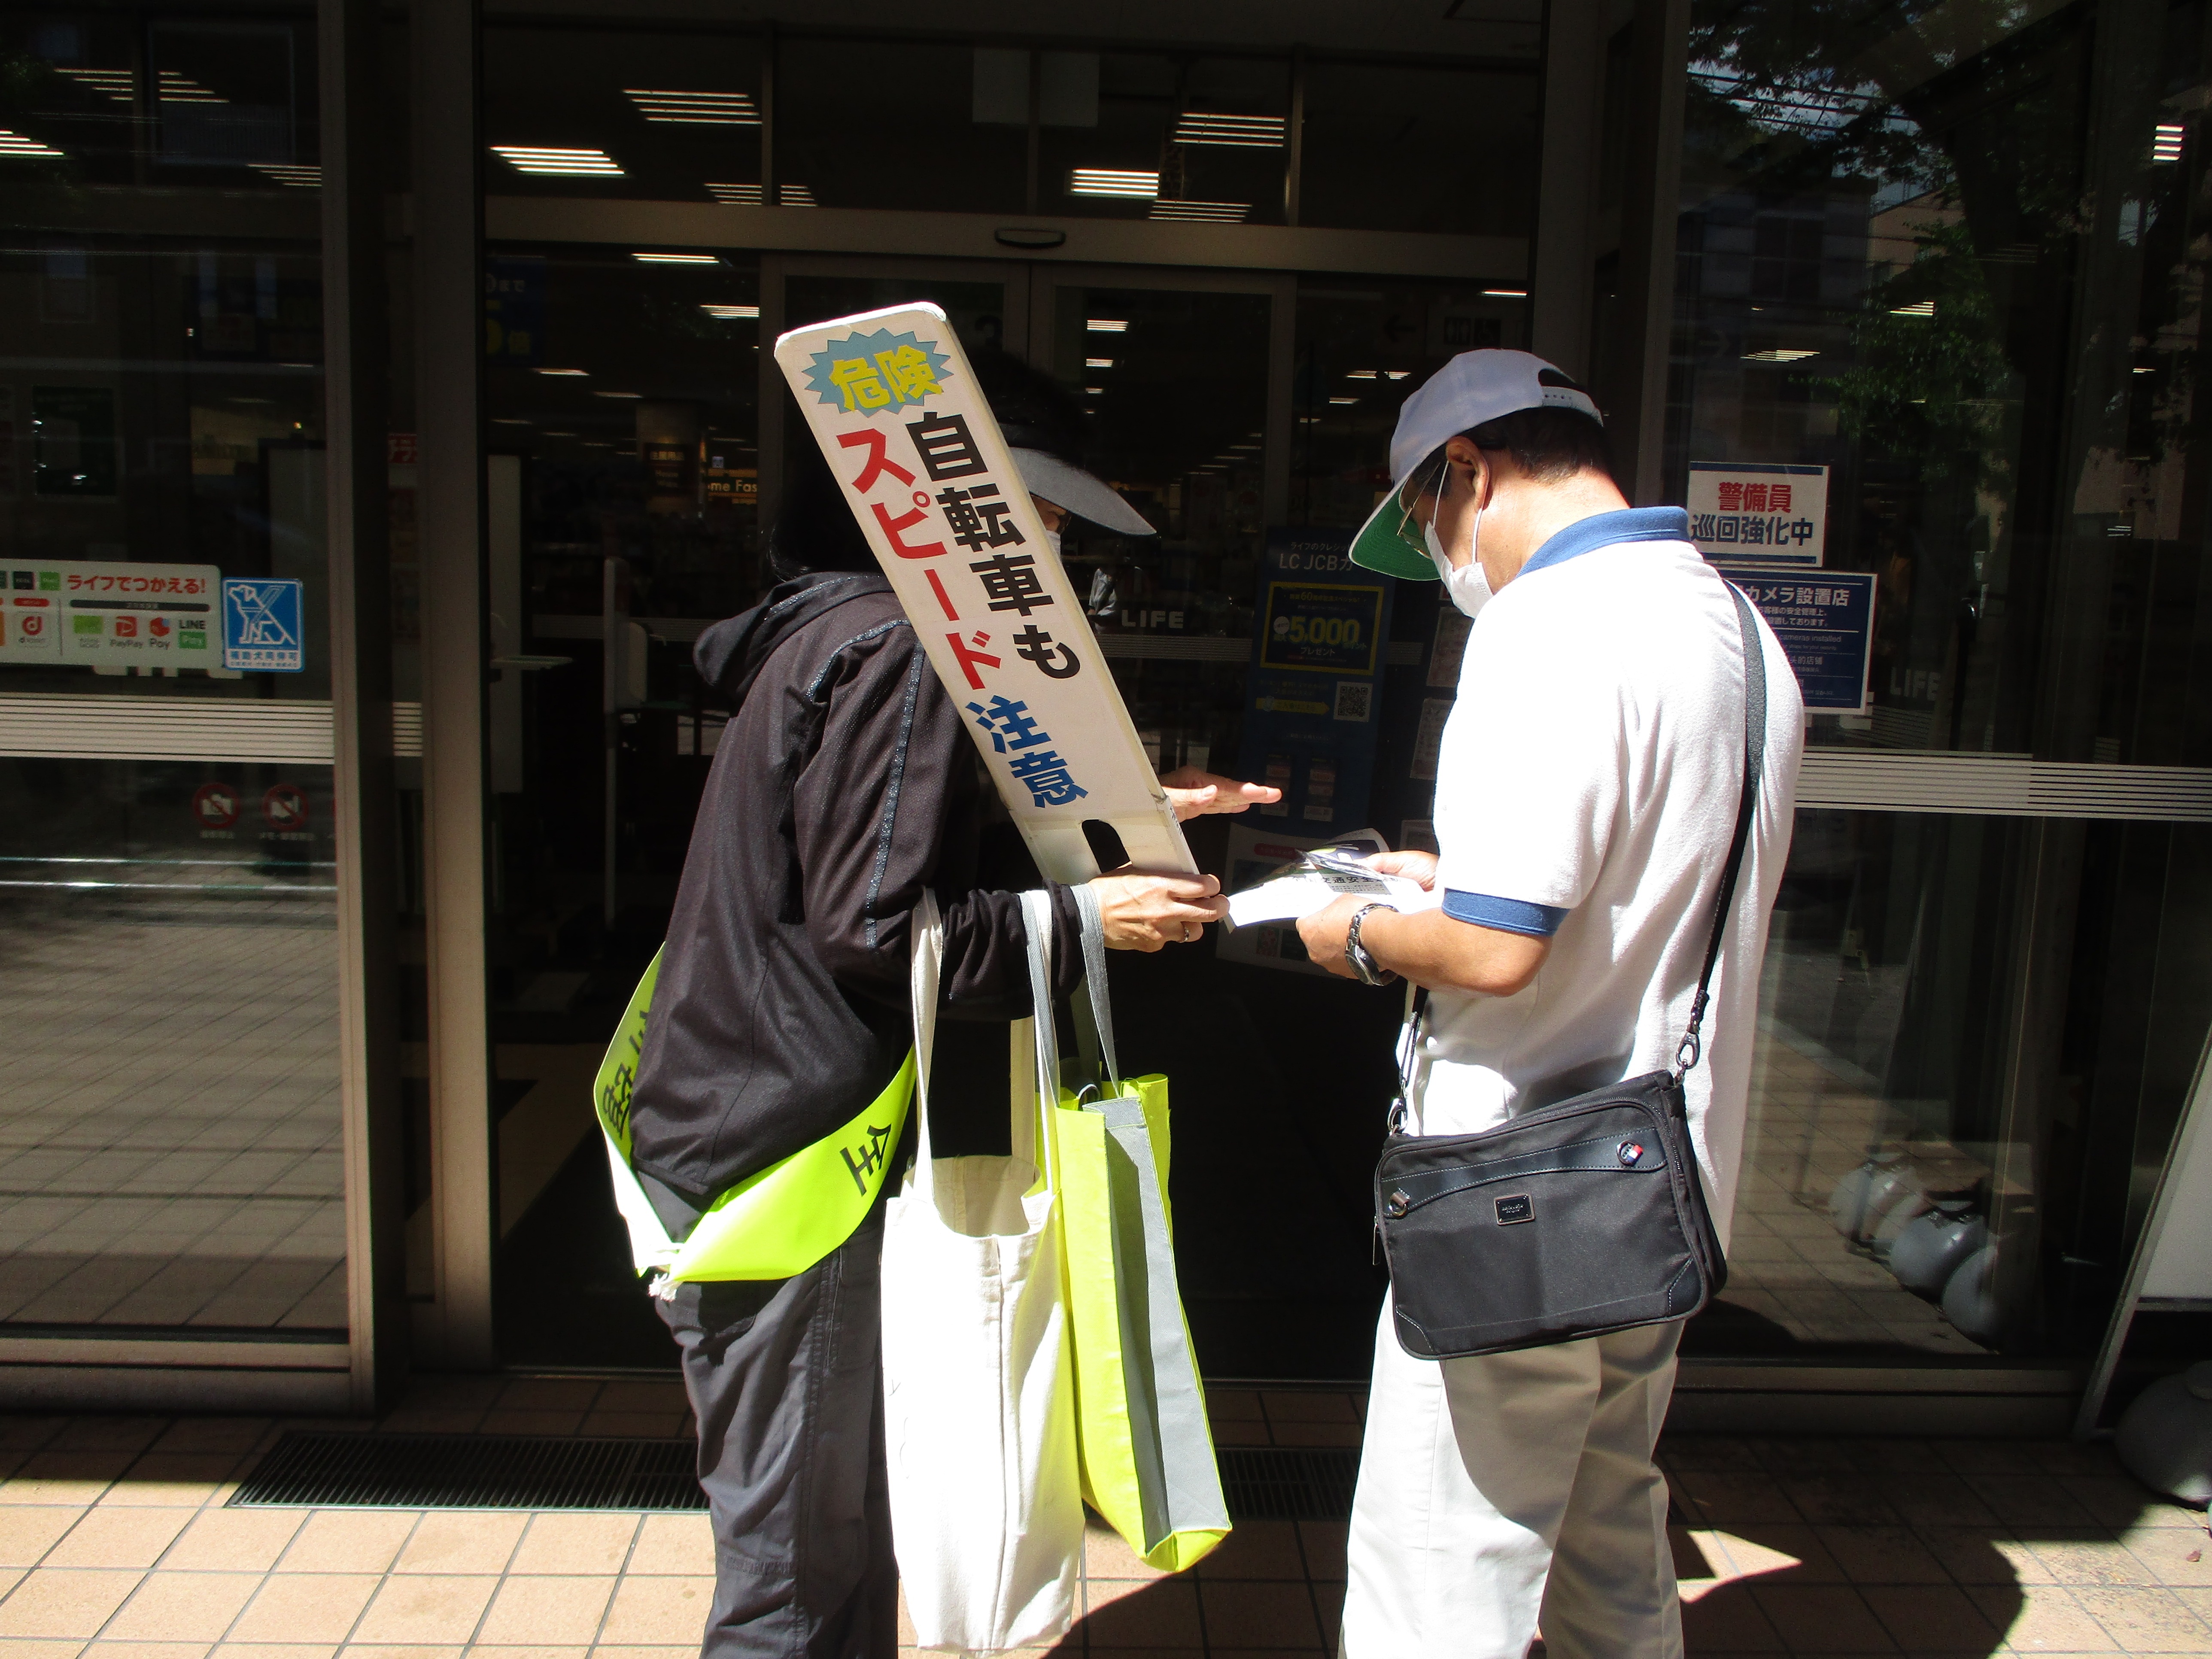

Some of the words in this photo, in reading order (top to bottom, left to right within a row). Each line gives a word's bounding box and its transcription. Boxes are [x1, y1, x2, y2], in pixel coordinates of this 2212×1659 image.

[830, 346, 942, 411] 危険
[1719, 482, 1791, 514] 警備員
[1691, 514, 1813, 546] 巡回強化中
[905, 412, 1079, 677] 自転車も
[1279, 553, 1300, 569] LC
[179, 620, 205, 629] LINE
[1121, 609, 1184, 629] LIFE
[1290, 616, 1360, 645] 5,000
[149, 638, 170, 649] Pay
[1300, 647, 1336, 656] プレゼント
